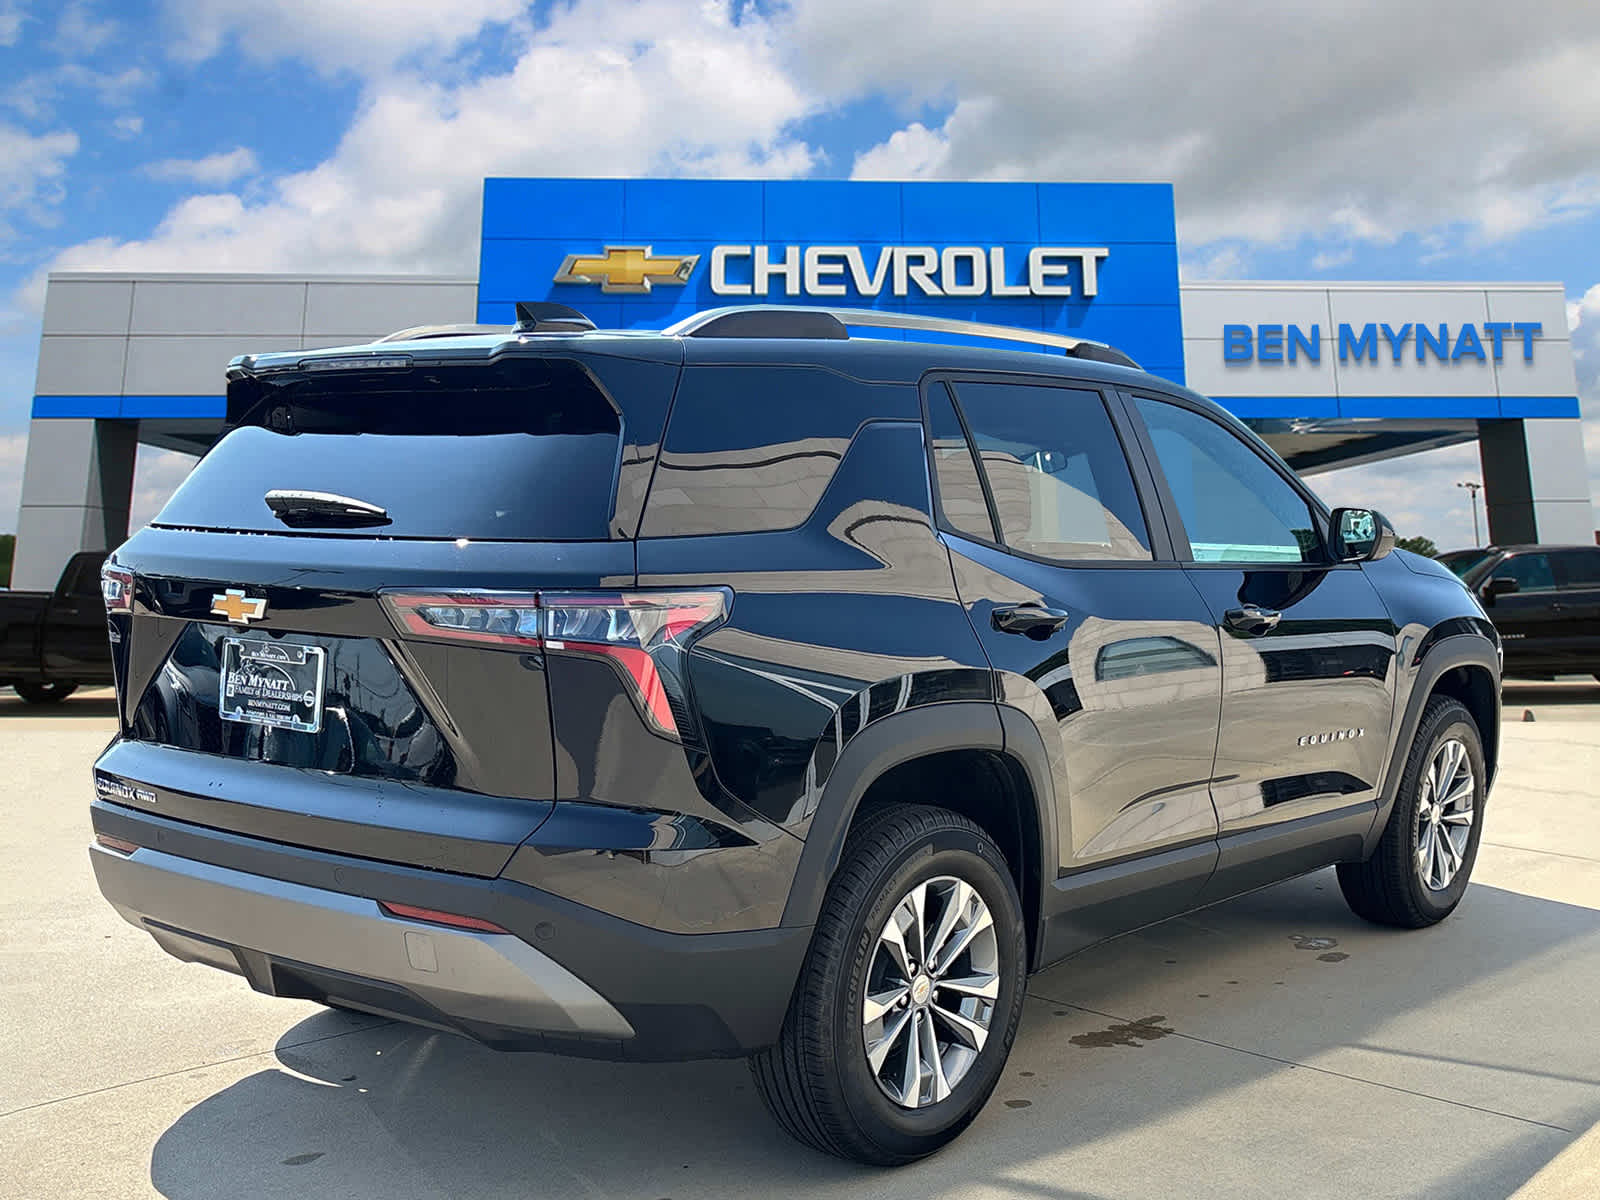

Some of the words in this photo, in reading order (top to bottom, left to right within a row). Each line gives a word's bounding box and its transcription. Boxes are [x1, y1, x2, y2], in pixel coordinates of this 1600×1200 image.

[710, 245, 1110, 297] CHEVROLET
[1223, 324, 1321, 362] BEN
[1338, 322, 1543, 362] MYNATT
[228, 671, 248, 685] BEN
[248, 674, 290, 691] MYNATT
[1297, 727, 1365, 746] EQUINOX
[846, 930, 872, 1031] MICHELIN
